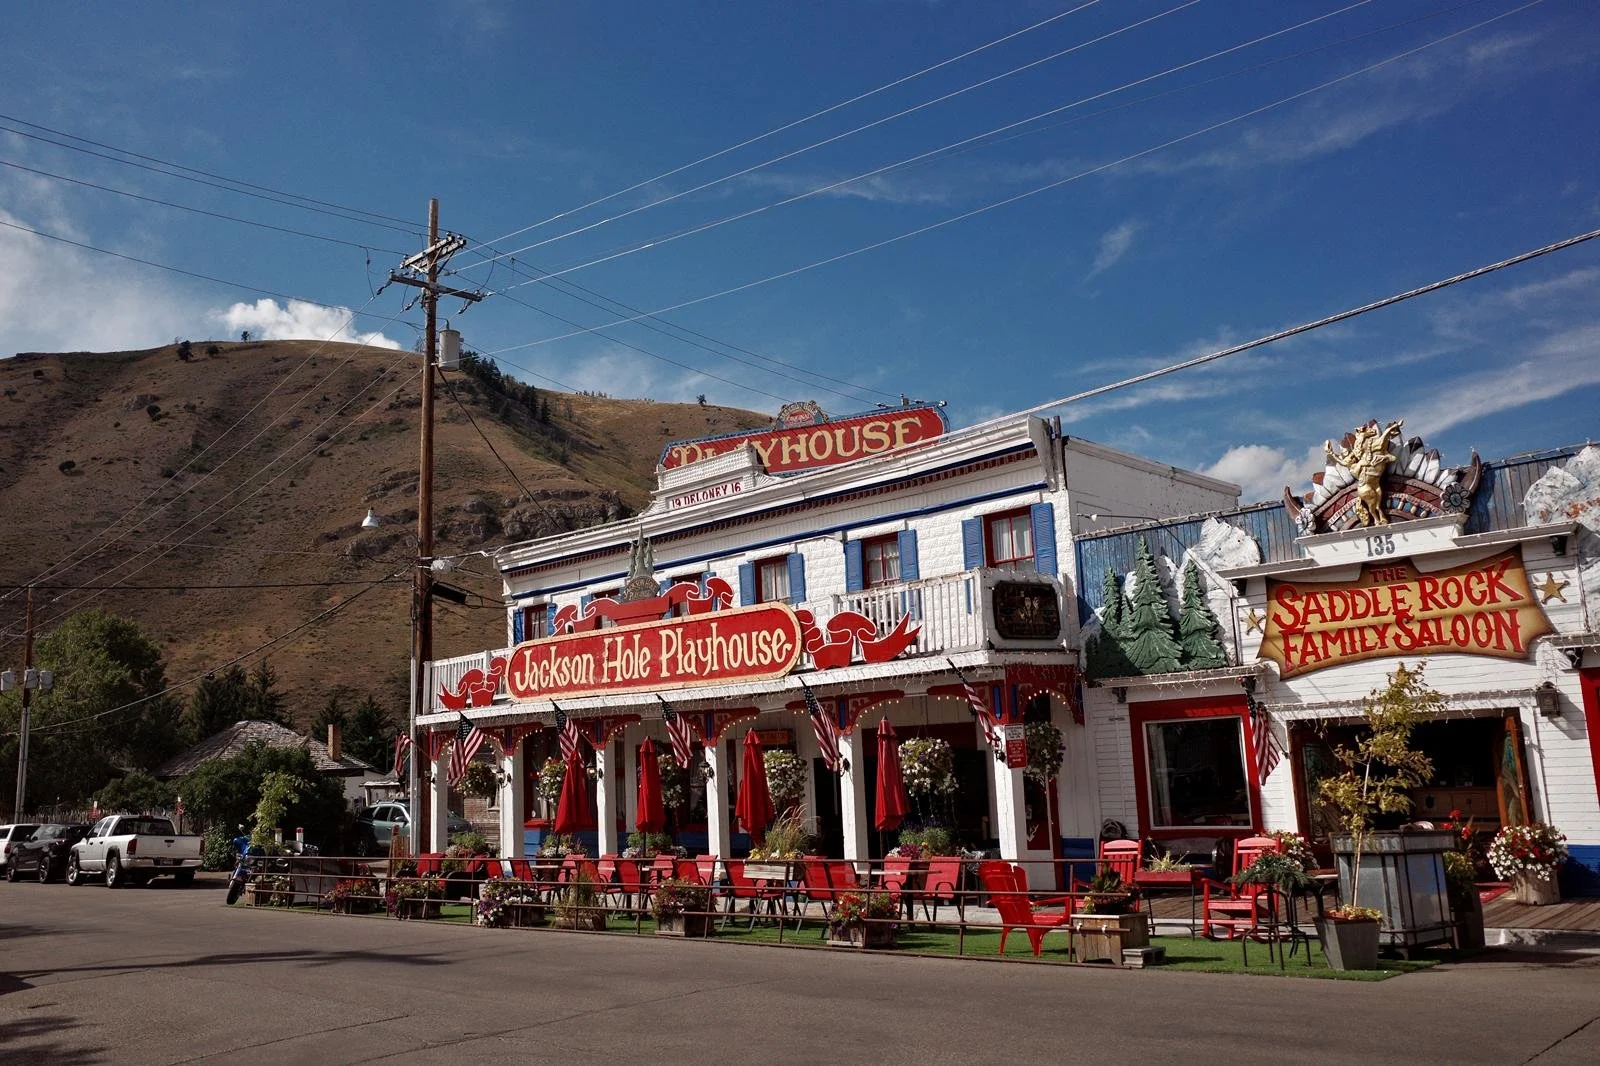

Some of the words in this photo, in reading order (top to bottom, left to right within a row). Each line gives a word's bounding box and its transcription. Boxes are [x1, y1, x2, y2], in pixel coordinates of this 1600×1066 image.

[672, 417, 922, 468] PYHOUSE
[671, 499, 682, 509] 19
[684, 485, 728, 506] DELONEY
[731, 482, 741, 495] 16
[1365, 534, 1395, 557] 135
[1272, 583, 1413, 631] SADDLE
[1415, 555, 1525, 612] ROCK
[1369, 566, 1408, 583] THE
[514, 646, 596, 692] Jackson
[601, 633, 651, 684] Hole
[658, 622, 793, 678] Playhouse
[1279, 622, 1394, 673] FAMILY
[1392, 608, 1525, 653] SALOON
